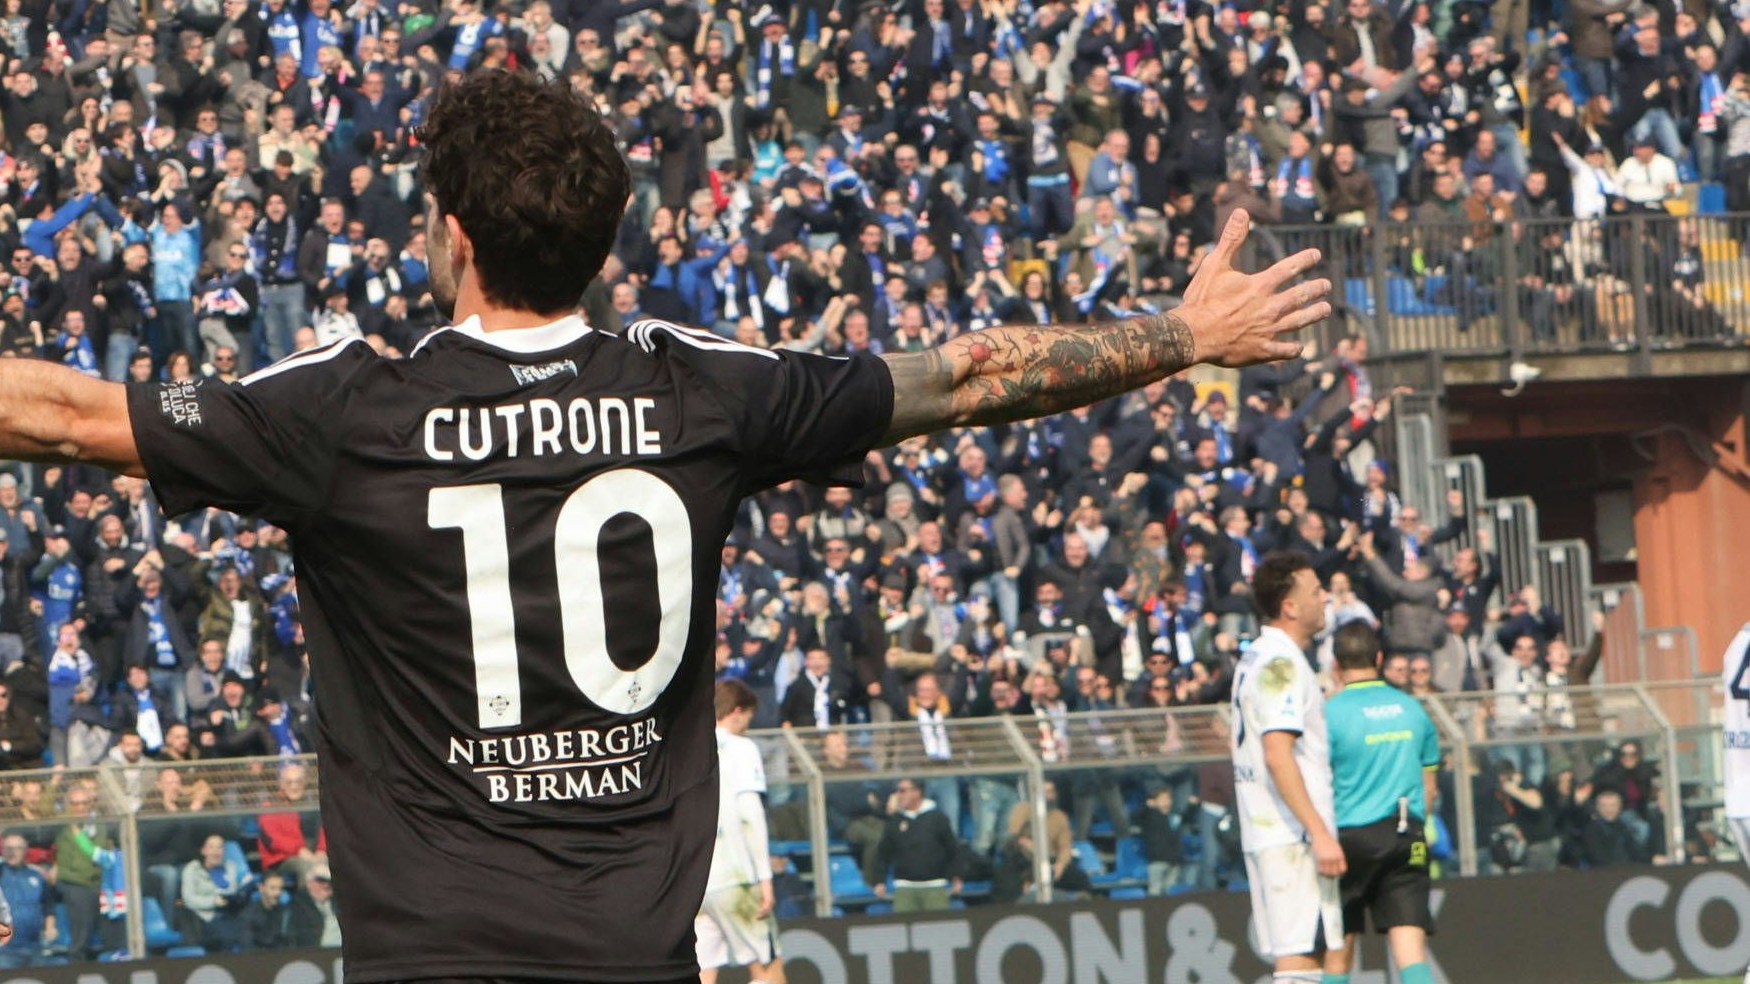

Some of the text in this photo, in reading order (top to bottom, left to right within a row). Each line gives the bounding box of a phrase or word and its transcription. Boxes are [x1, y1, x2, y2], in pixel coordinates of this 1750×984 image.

[424, 397, 661, 461] CUTRONE
[427, 468, 693, 729] 10
[447, 717, 663, 766] NEUBERGER
[486, 761, 642, 802] BERMAN
